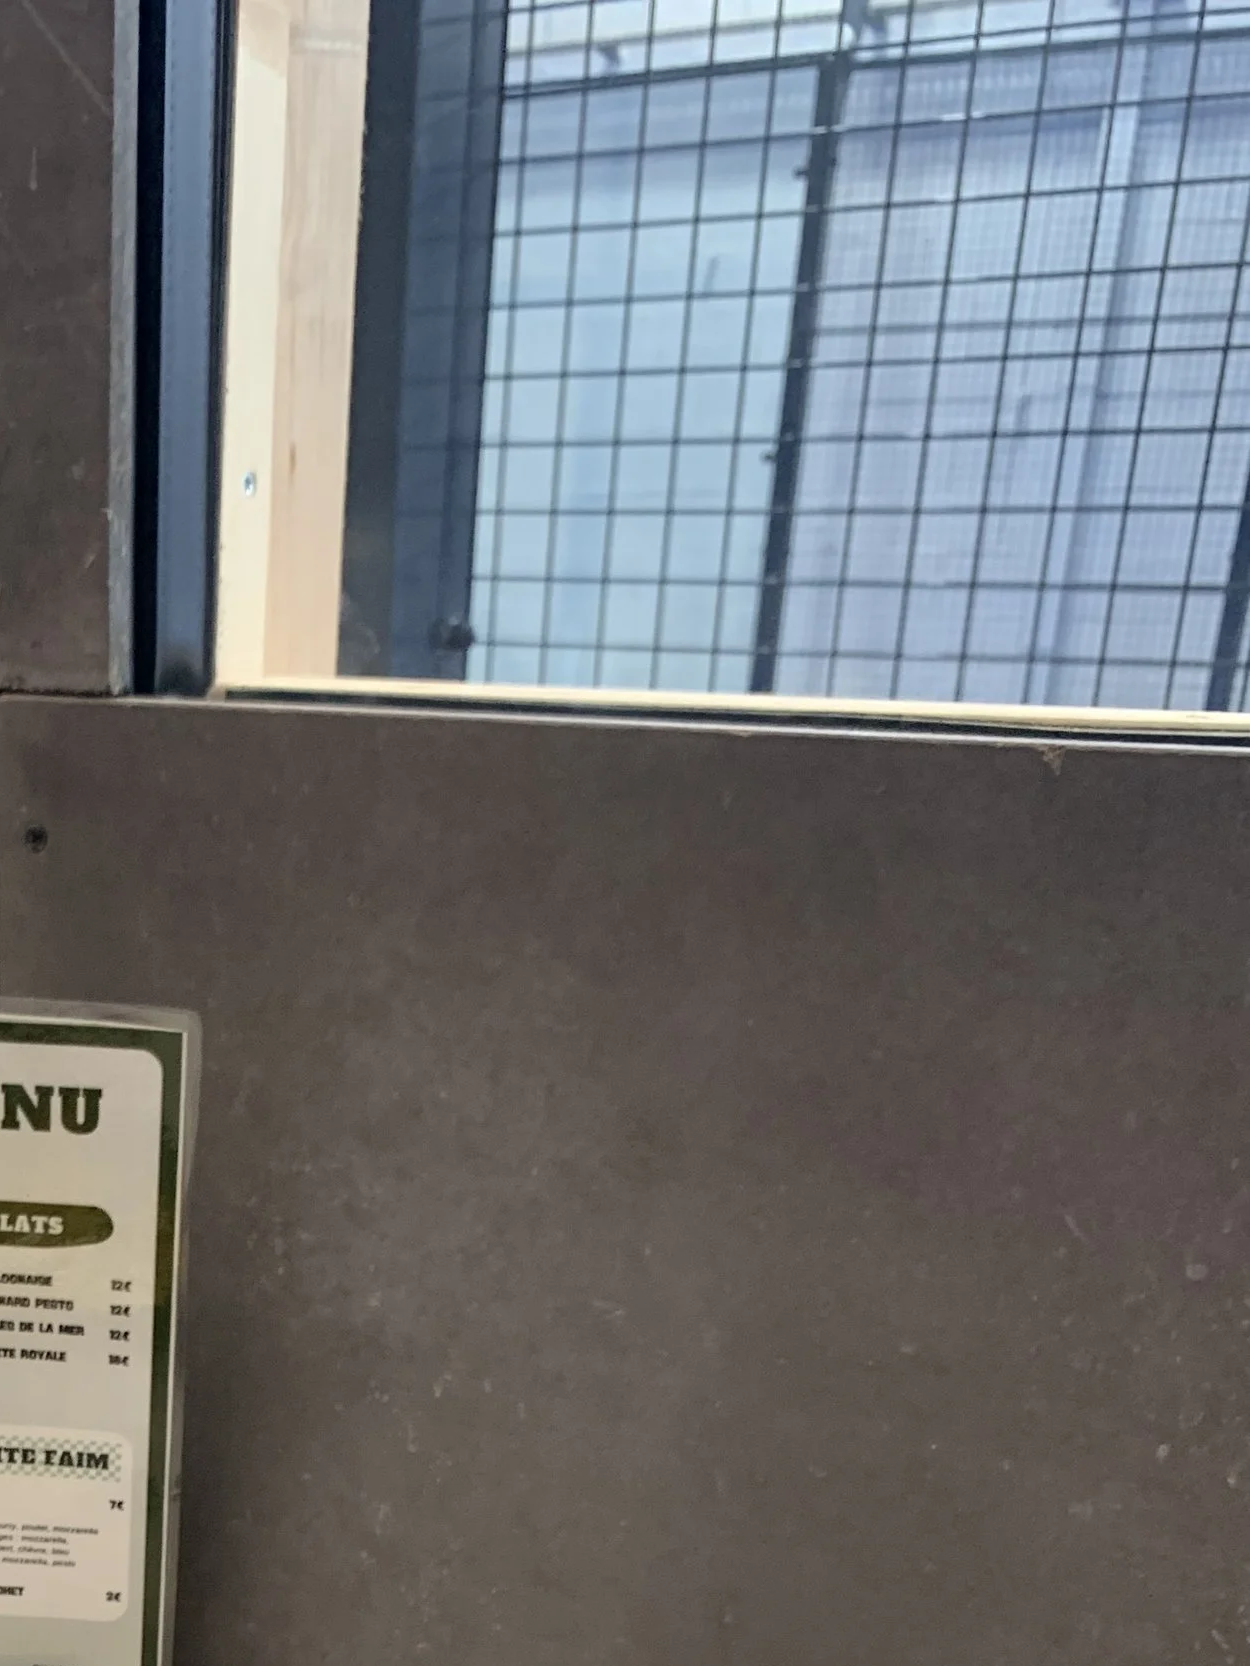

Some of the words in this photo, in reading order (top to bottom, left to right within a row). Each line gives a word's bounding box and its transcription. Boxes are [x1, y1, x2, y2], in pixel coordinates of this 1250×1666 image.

[35, 1298, 74, 1311] PESTO
[19, 1321, 34, 1332] DE
[39, 1322, 53, 1333] LA
[59, 1325, 85, 1336] MER
[20, 1349, 66, 1362] ROYALE
[44, 1450, 109, 1470] FAIM
[109, 1499, 124, 1511] 7€
[53, 1525, 98, 1535] mozzarella
[106, 1591, 121, 1602] 2€
